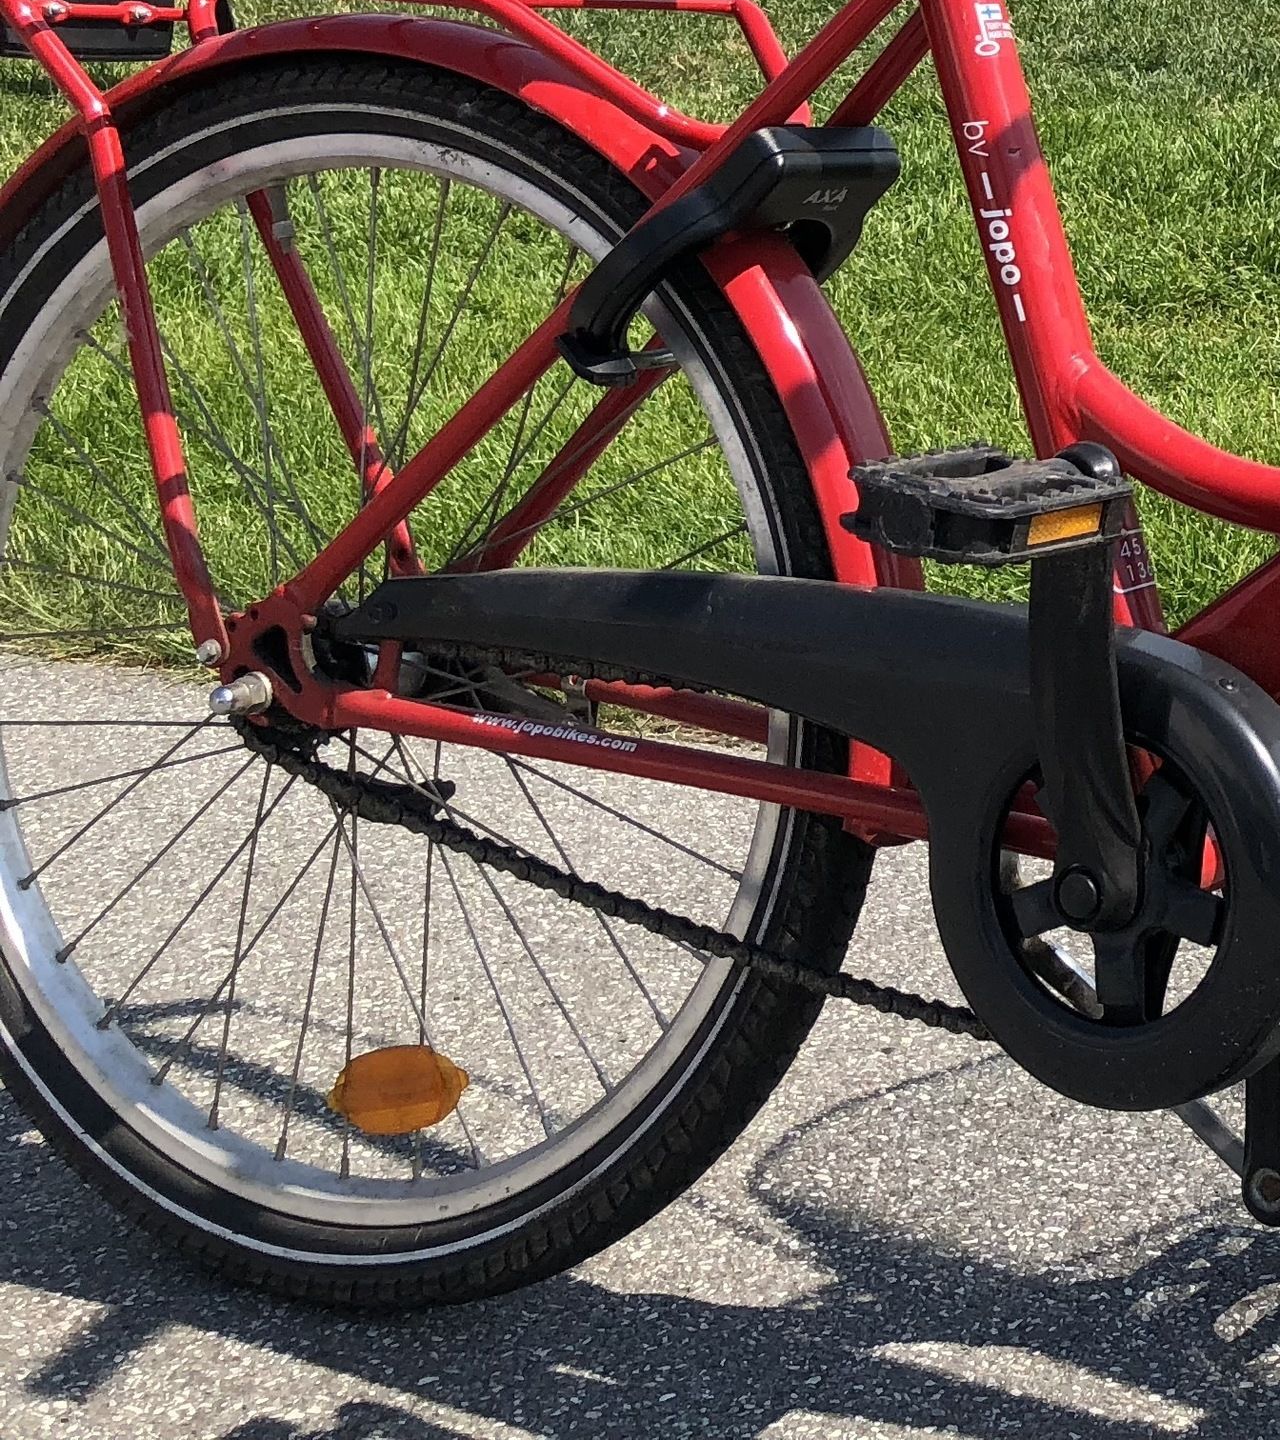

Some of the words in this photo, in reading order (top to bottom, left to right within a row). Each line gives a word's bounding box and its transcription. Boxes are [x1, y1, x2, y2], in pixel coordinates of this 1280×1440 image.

[802, 186, 848, 205] AXA
[981, 208, 1021, 286] jopo
[472, 712, 637, 753] www.jopobikes.com
